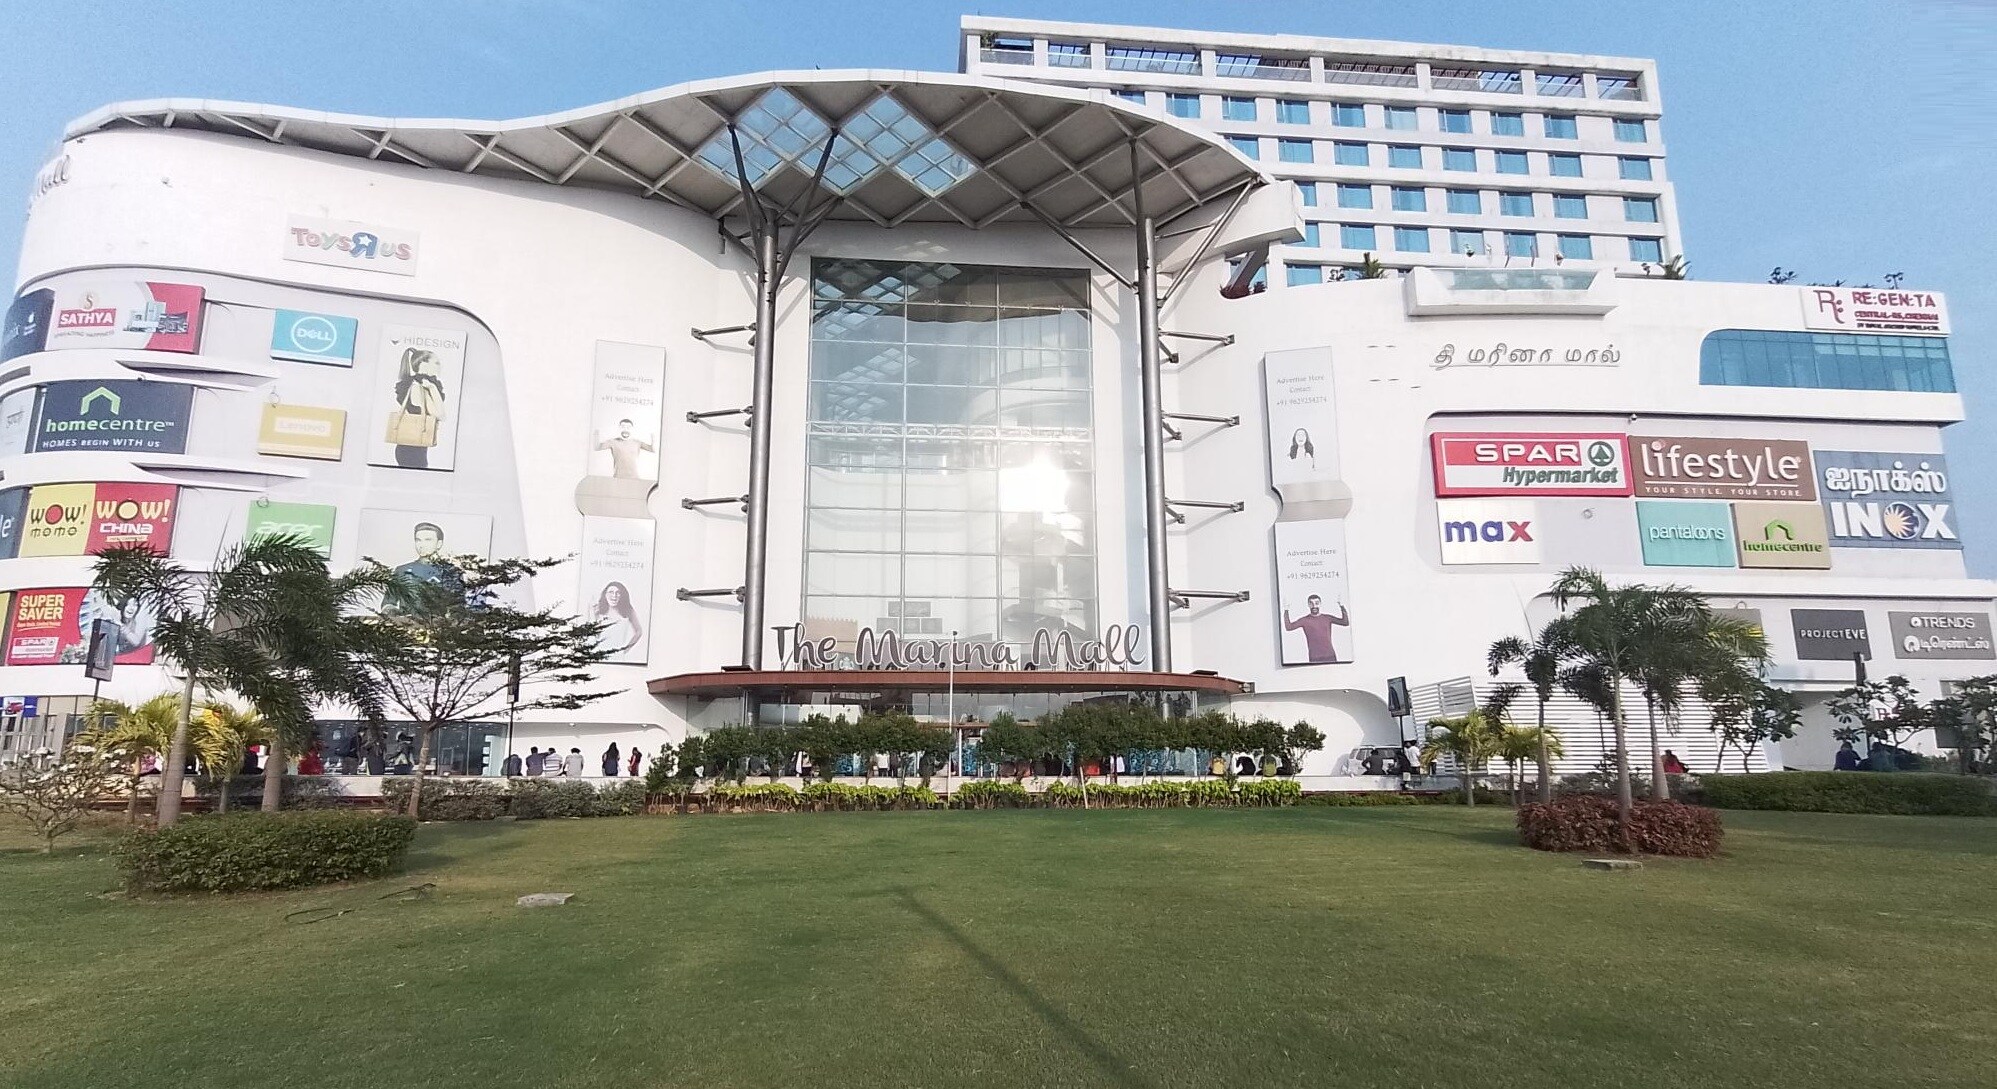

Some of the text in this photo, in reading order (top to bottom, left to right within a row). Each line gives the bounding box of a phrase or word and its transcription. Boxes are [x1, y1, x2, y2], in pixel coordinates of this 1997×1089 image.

[60, 312, 114, 326] SATHYA
[297, 328, 333, 341] DELL
[404, 336, 460, 350] HIDESIGN
[1565, 344, 1620, 363] மால்
[43, 438, 161, 448] HOMES BEGIN WITH US
[1474, 443, 1580, 463] SPAR
[1641, 441, 1799, 487] lifestyle
[1502, 466, 1618, 486] Hypermarket
[1825, 461, 1946, 498] ஐநாக்ஸ்
[1645, 486, 1675, 494] YOUR
[1731, 488, 1758, 496] YOUR
[1830, 501, 1957, 540] INOX
[1444, 520, 1534, 543] max
[1650, 524, 1726, 541] pantaloons
[1287, 548, 1336, 557] Advertise Here
[1743, 540, 1823, 552] homecentre
[20, 594, 65, 608] SUPER
[19, 607, 63, 621] SAVER
[1921, 616, 1976, 629] TRENDS
[771, 623, 1147, 668] The Marina Mall
